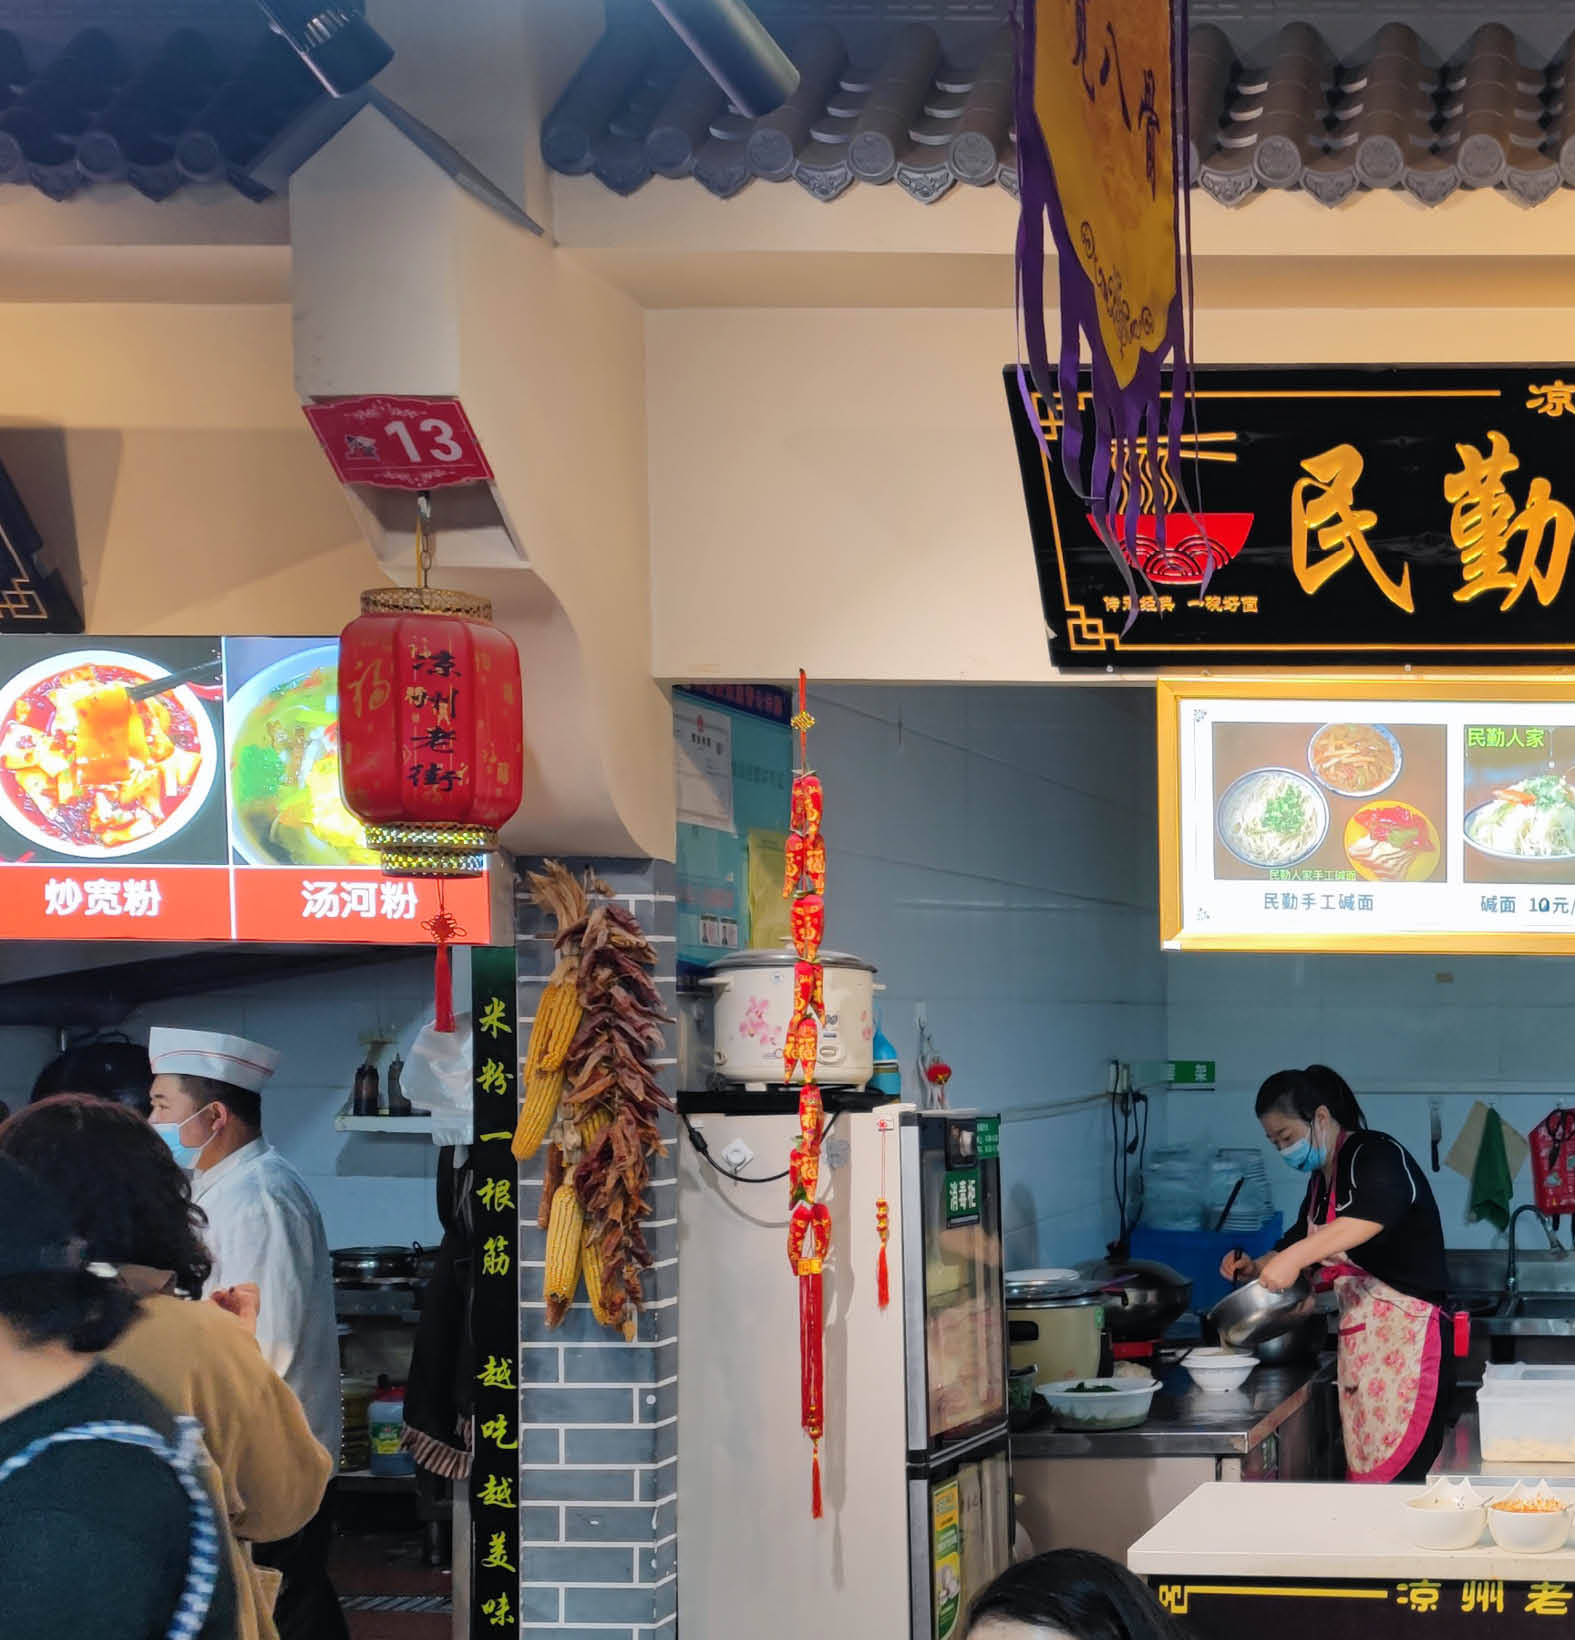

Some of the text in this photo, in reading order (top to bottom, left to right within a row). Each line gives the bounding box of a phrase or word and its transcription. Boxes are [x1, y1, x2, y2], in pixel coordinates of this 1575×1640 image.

[384, 418, 463, 462] 13
[406, 650, 463, 793] 凉州老街
[1468, 727, 1545, 748] 民勤人家
[44, 878, 162, 917] 炒宽粉
[301, 880, 418, 920] 汤河粉
[1264, 892, 1375, 912] 民勤手工碱面
[1480, 895, 1516, 914] 碱面
[474, 998, 516, 1277] 米粉一根筋
[474, 1355, 517, 1628] 越吃越美味
